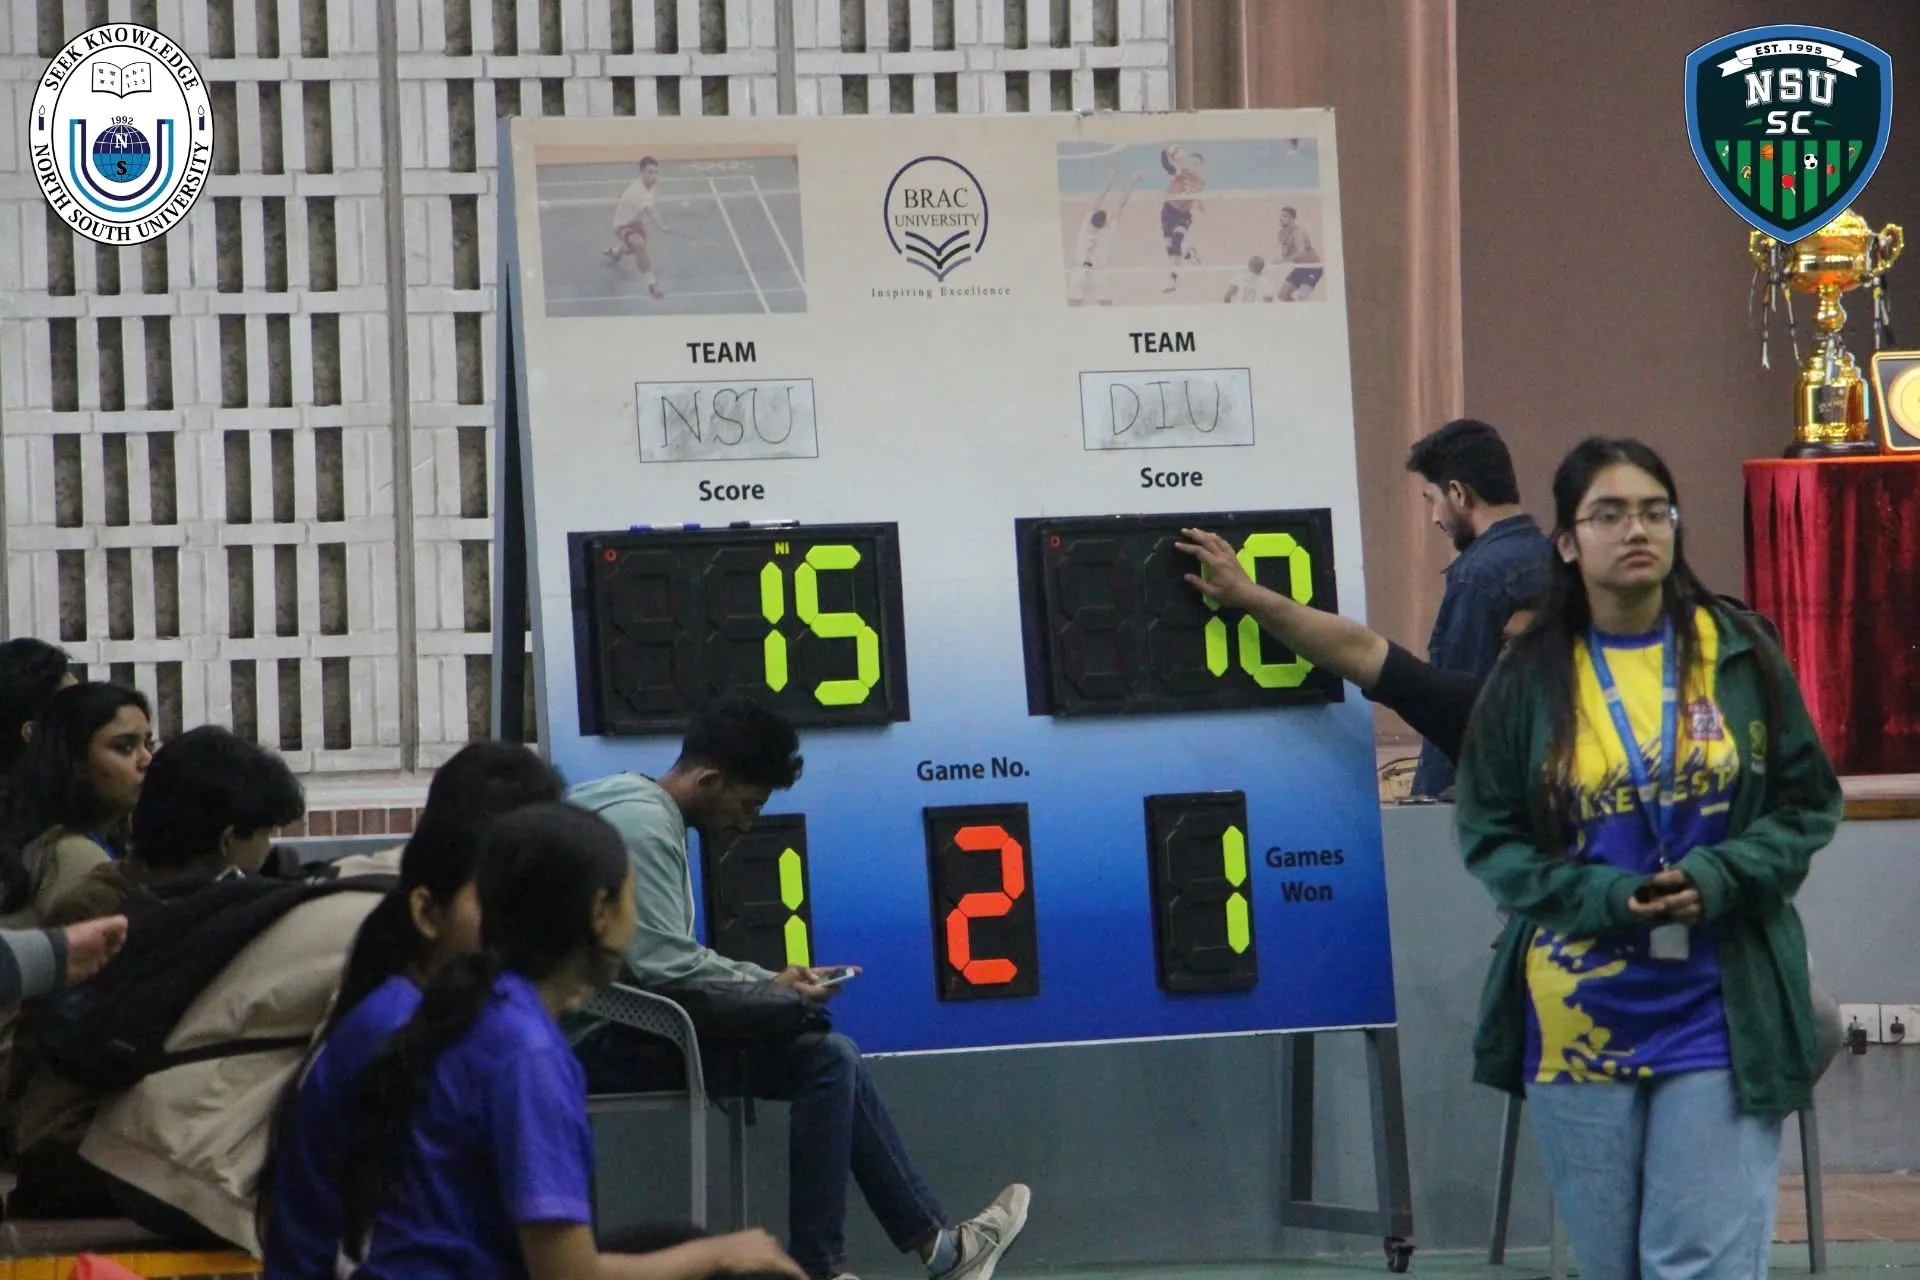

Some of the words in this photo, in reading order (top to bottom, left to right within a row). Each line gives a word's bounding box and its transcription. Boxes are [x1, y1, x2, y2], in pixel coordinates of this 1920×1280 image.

[904, 187, 969, 209] BRAC
[894, 213, 980, 228] UNIVERSITY
[871, 286, 933, 300] Inspiring
[940, 285, 1012, 297] Excellence
[686, 341, 757, 364] TEAM
[1129, 331, 1196, 354] TEAM
[660, 386, 795, 448] NSU
[1109, 380, 1220, 435] DIU
[1140, 466, 1204, 488] Score
[699, 480, 765, 502] Score
[760, 545, 881, 706] 15
[916, 760, 985, 782] Game
[991, 757, 1030, 778] No.
[1265, 846, 1345, 868] Games
[1222, 825, 1250, 954] 1
[1280, 881, 1334, 904] Won
[778, 847, 810, 968] 1
[946, 825, 1025, 985] 2
